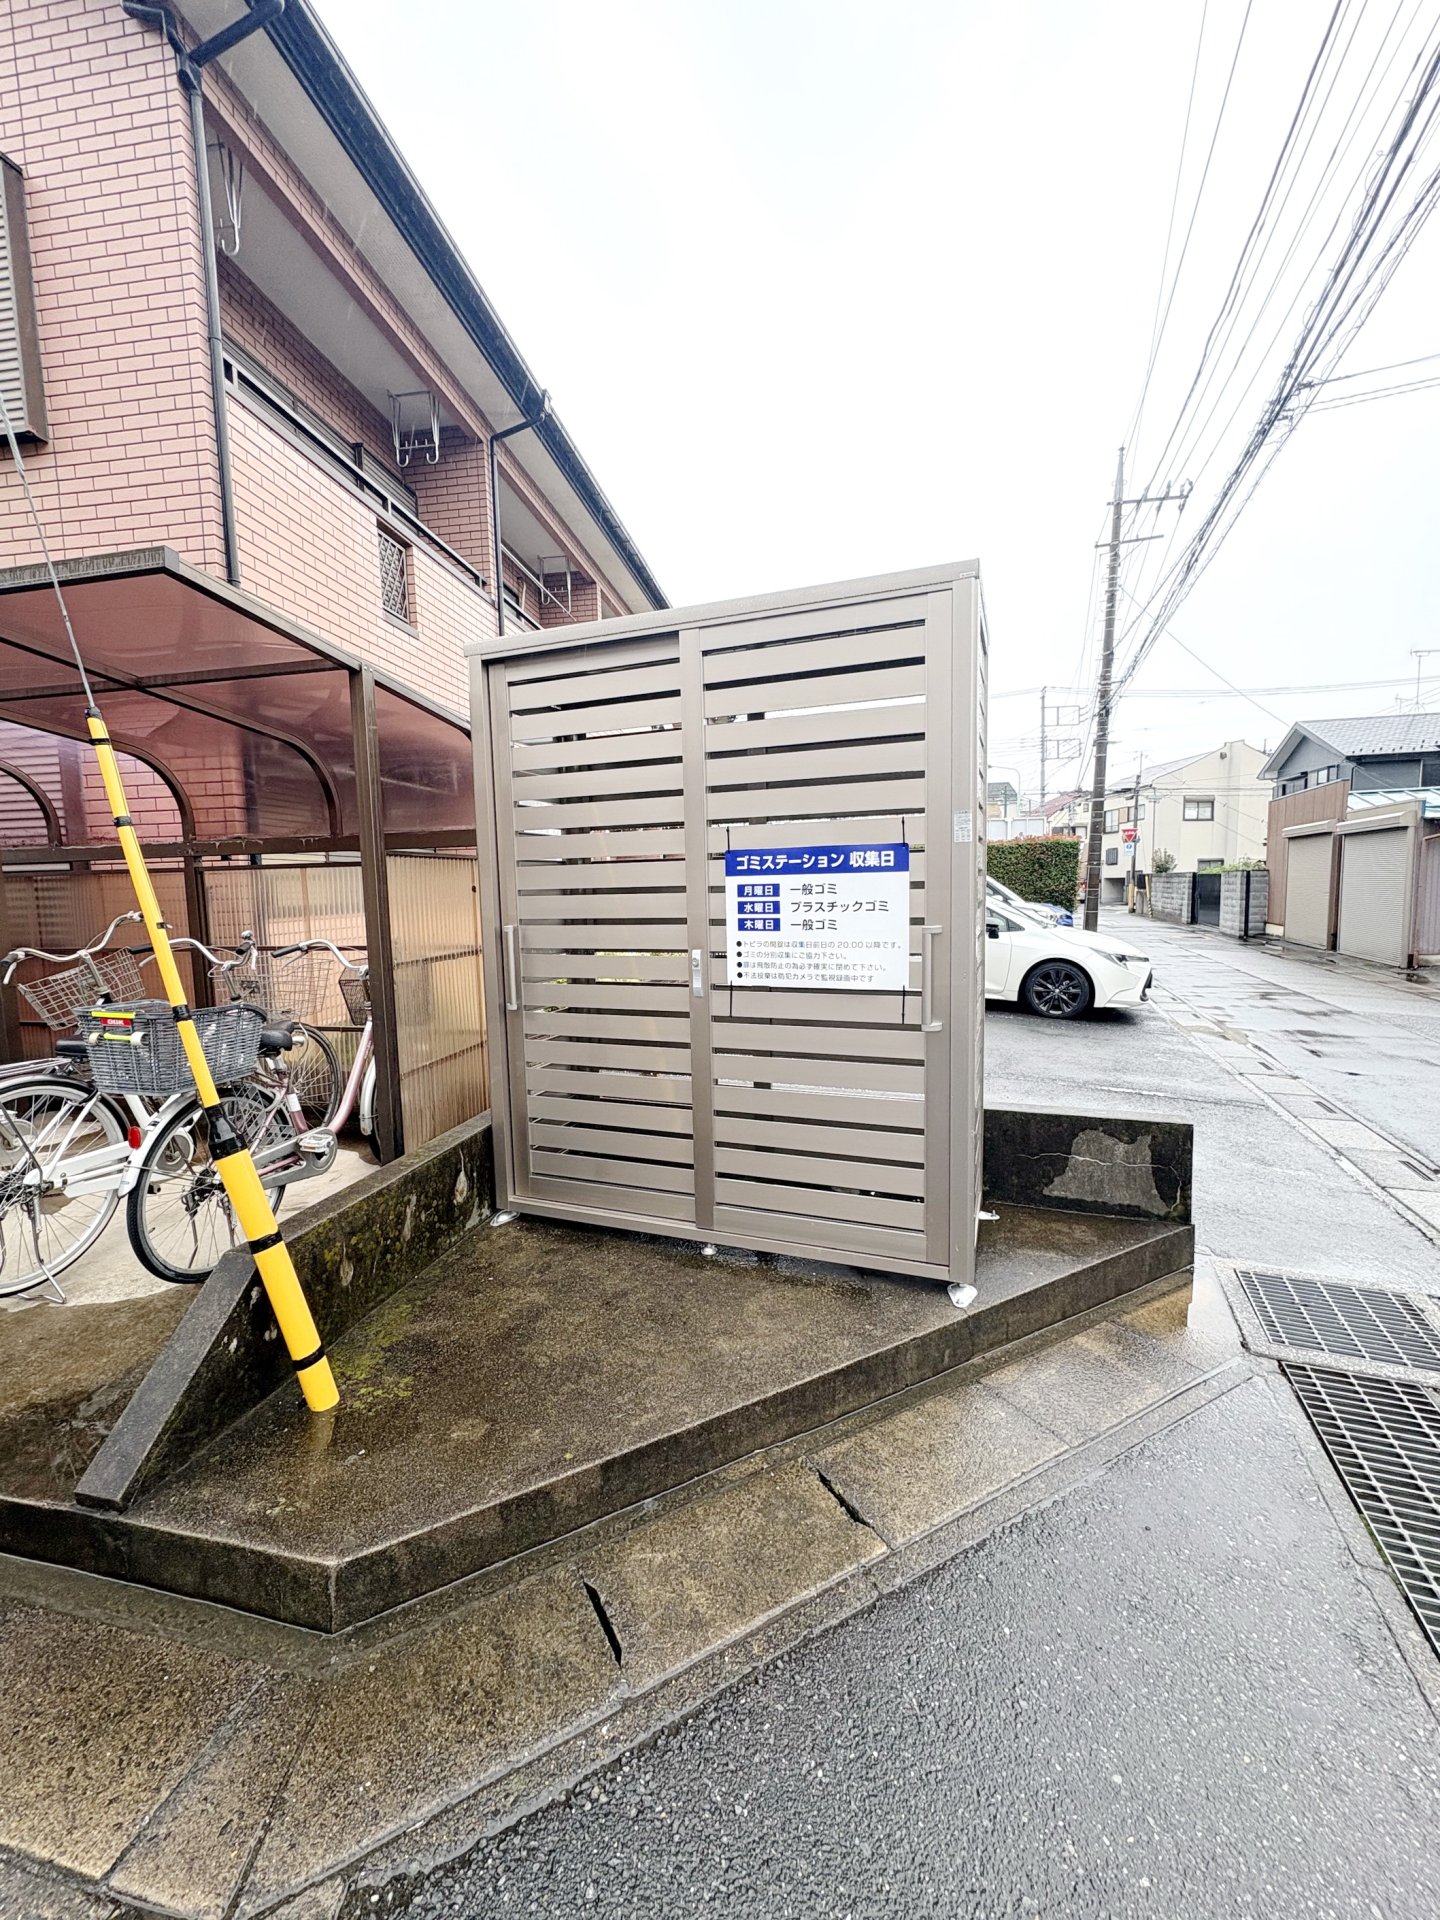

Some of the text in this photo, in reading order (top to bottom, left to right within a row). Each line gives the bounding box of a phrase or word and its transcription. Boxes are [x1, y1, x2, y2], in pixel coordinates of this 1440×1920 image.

[736, 851, 895, 871] ゴミステーション 収集日
[743, 883, 838, 896] 月曜日 一般ゴミ
[743, 901, 889, 913] 水曜日 プラスチックゴミ
[743, 919, 838, 931] 木曜日 一般ゴミ
